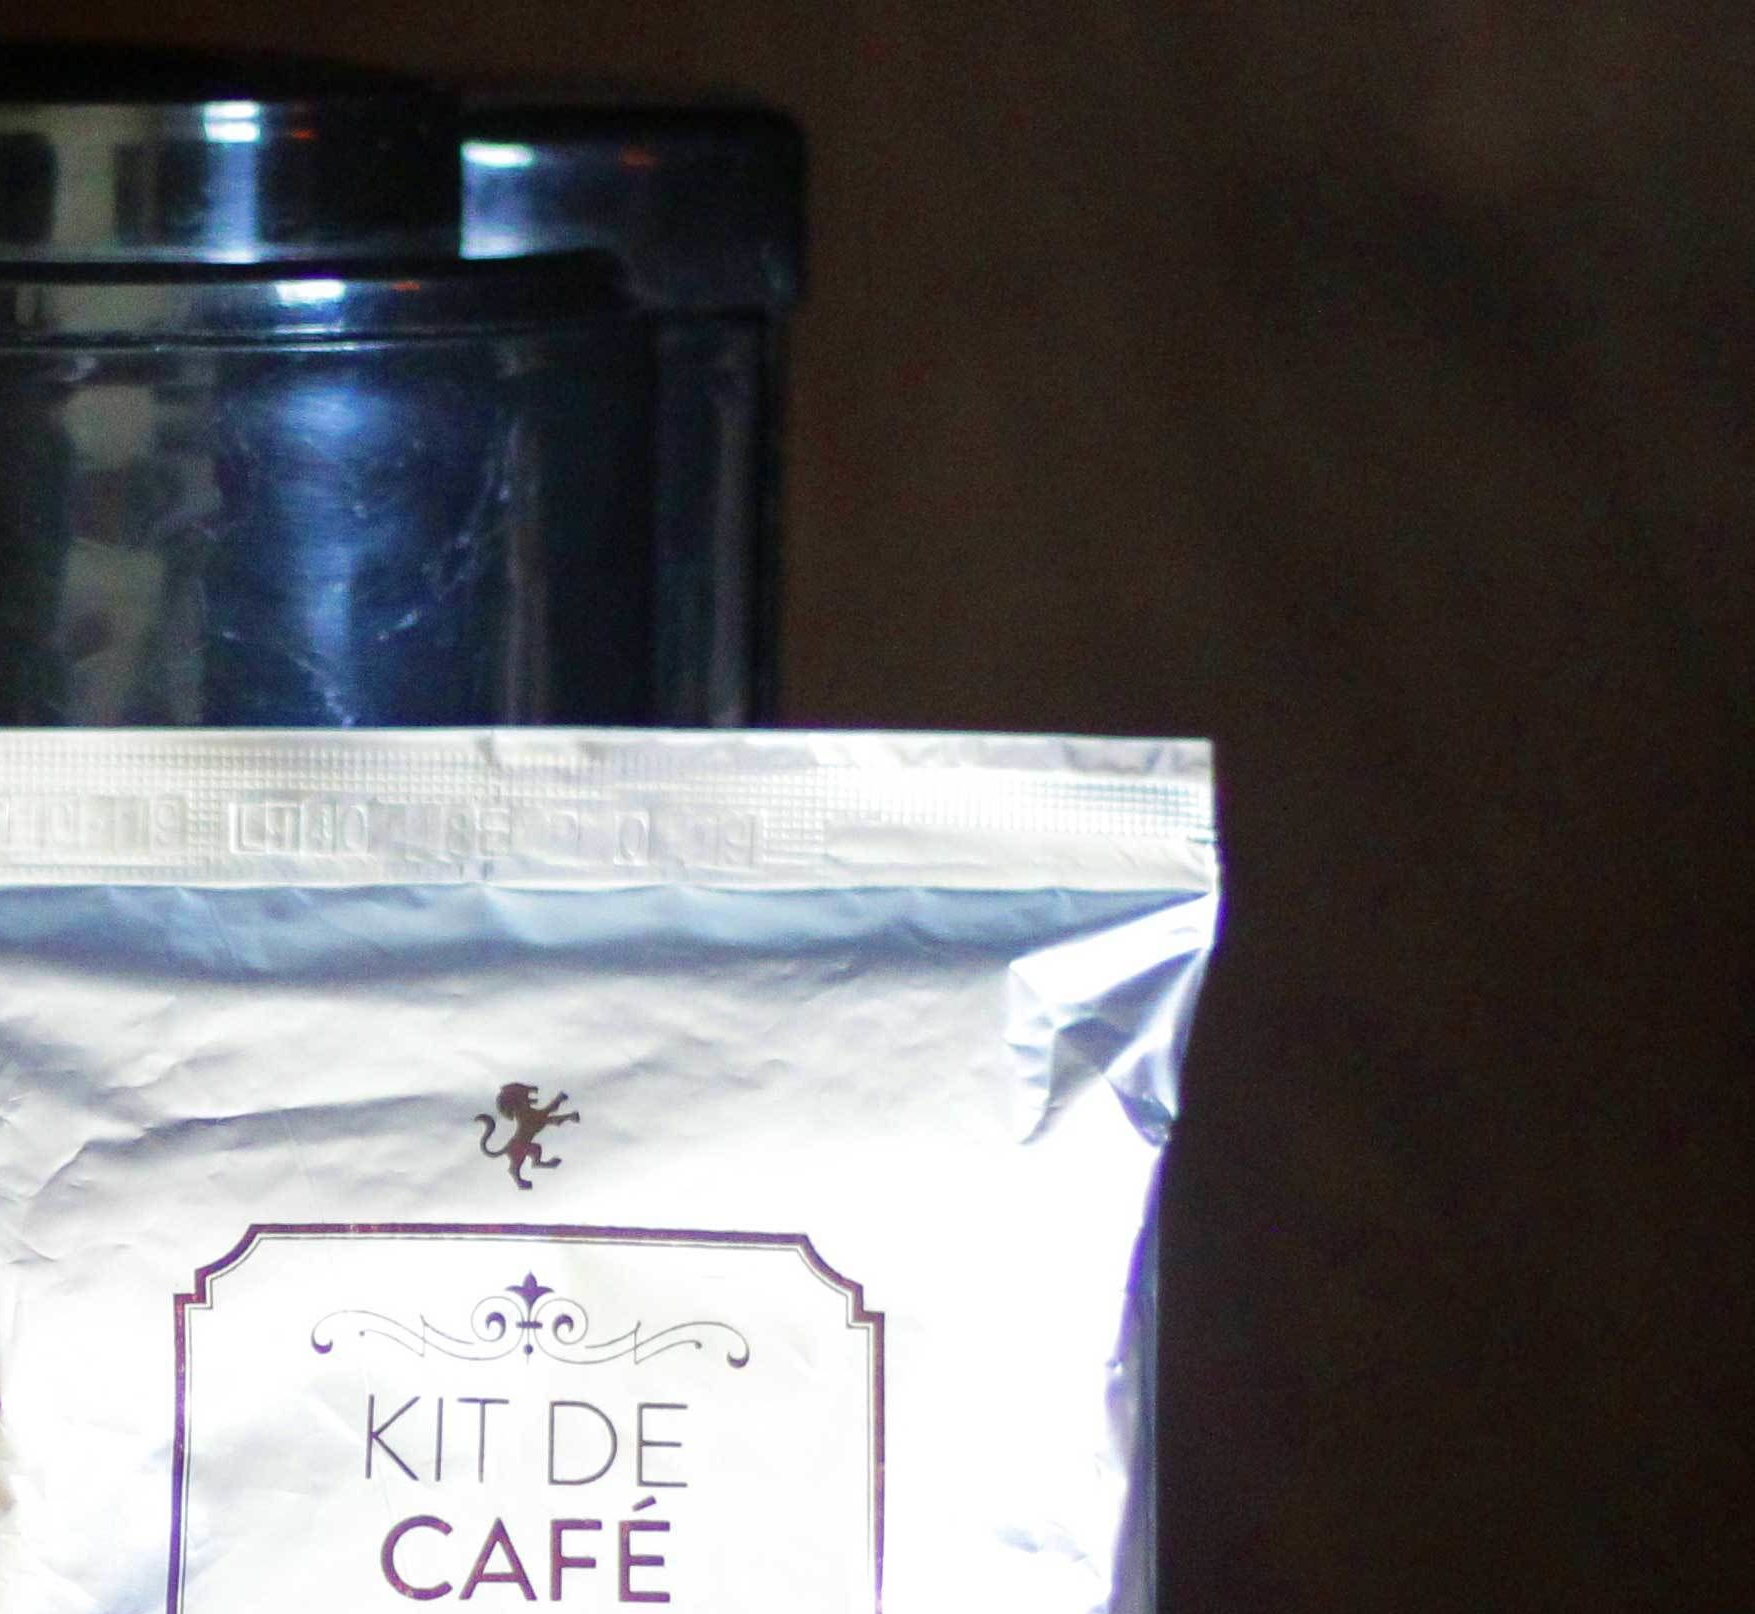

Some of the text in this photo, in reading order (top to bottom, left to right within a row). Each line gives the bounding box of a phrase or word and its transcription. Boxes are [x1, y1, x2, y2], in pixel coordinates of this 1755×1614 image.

[365, 1394, 688, 1487] KIT DE
[380, 1495, 671, 1603] CAFÉ
